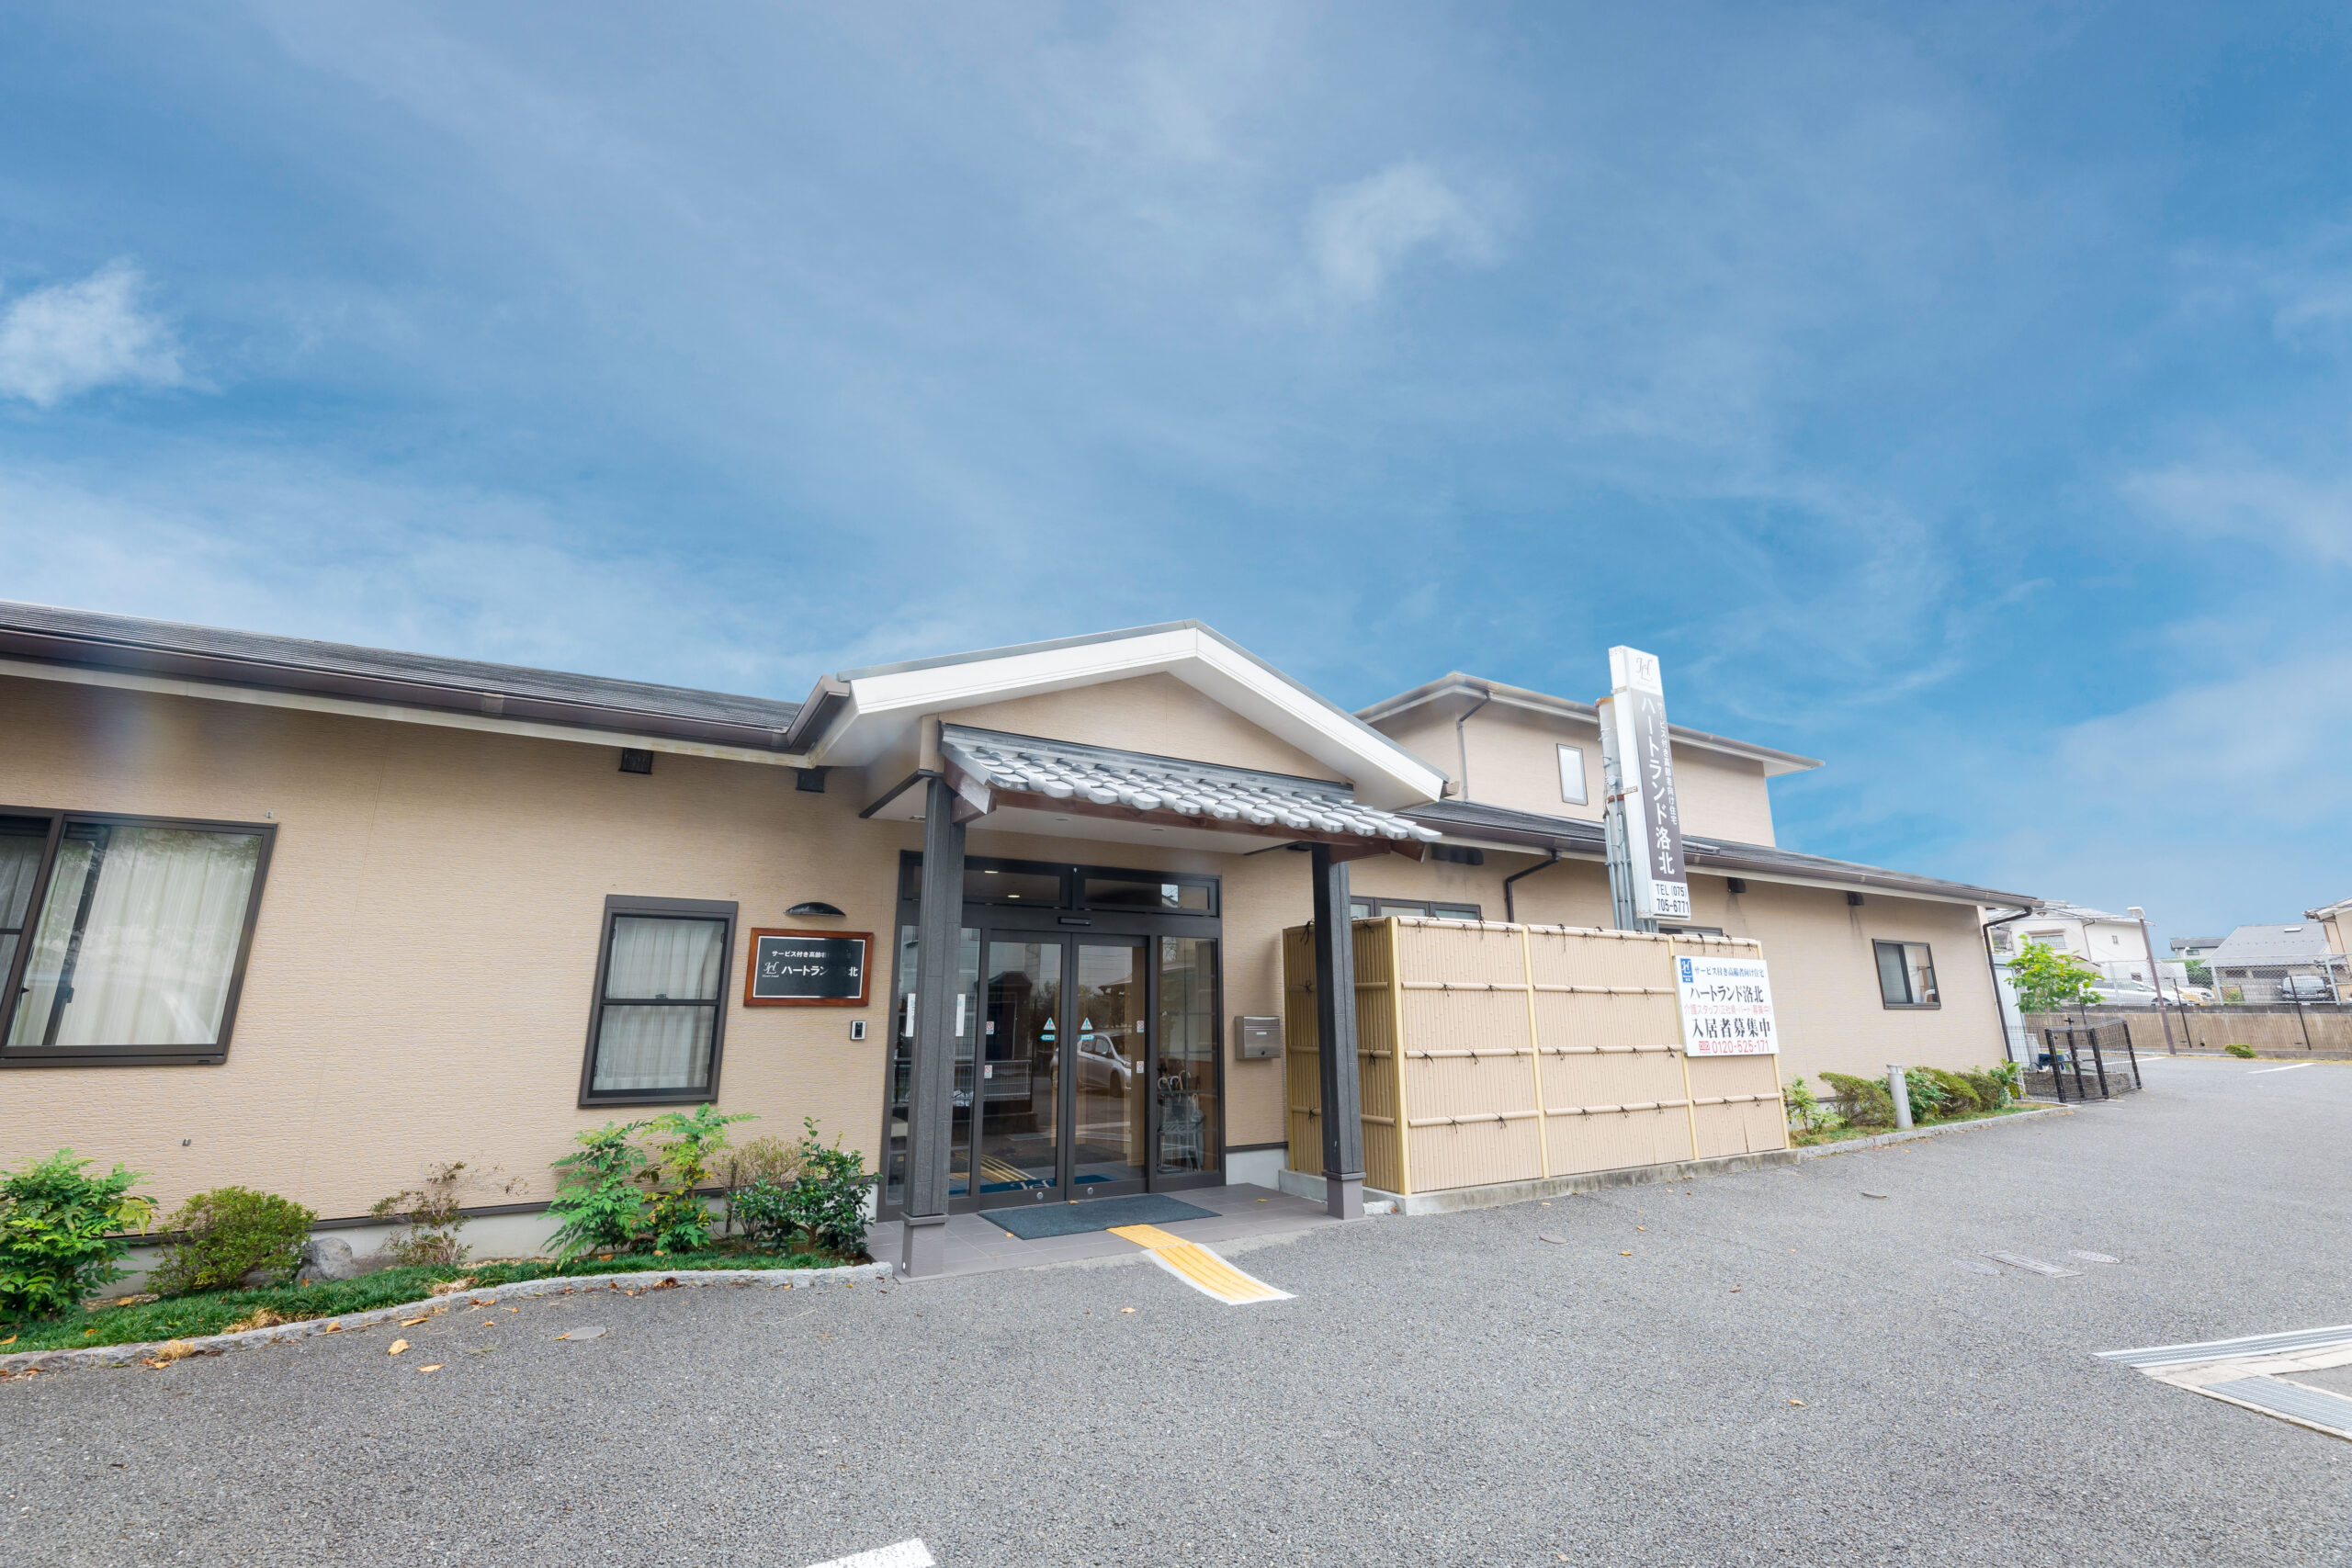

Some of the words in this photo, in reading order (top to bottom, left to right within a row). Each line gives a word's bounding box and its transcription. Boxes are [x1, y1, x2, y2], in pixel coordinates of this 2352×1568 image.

[1642, 697, 1675, 874] ハートランド洛北
[1656, 884, 1669, 897] TEL
[1670, 885, 1687, 897] (075)
[1657, 897, 1690, 913] 705-6771
[1690, 985, 1763, 1002] ハートランド洛北
[1692, 1018, 1770, 1038] 入居者募集中
